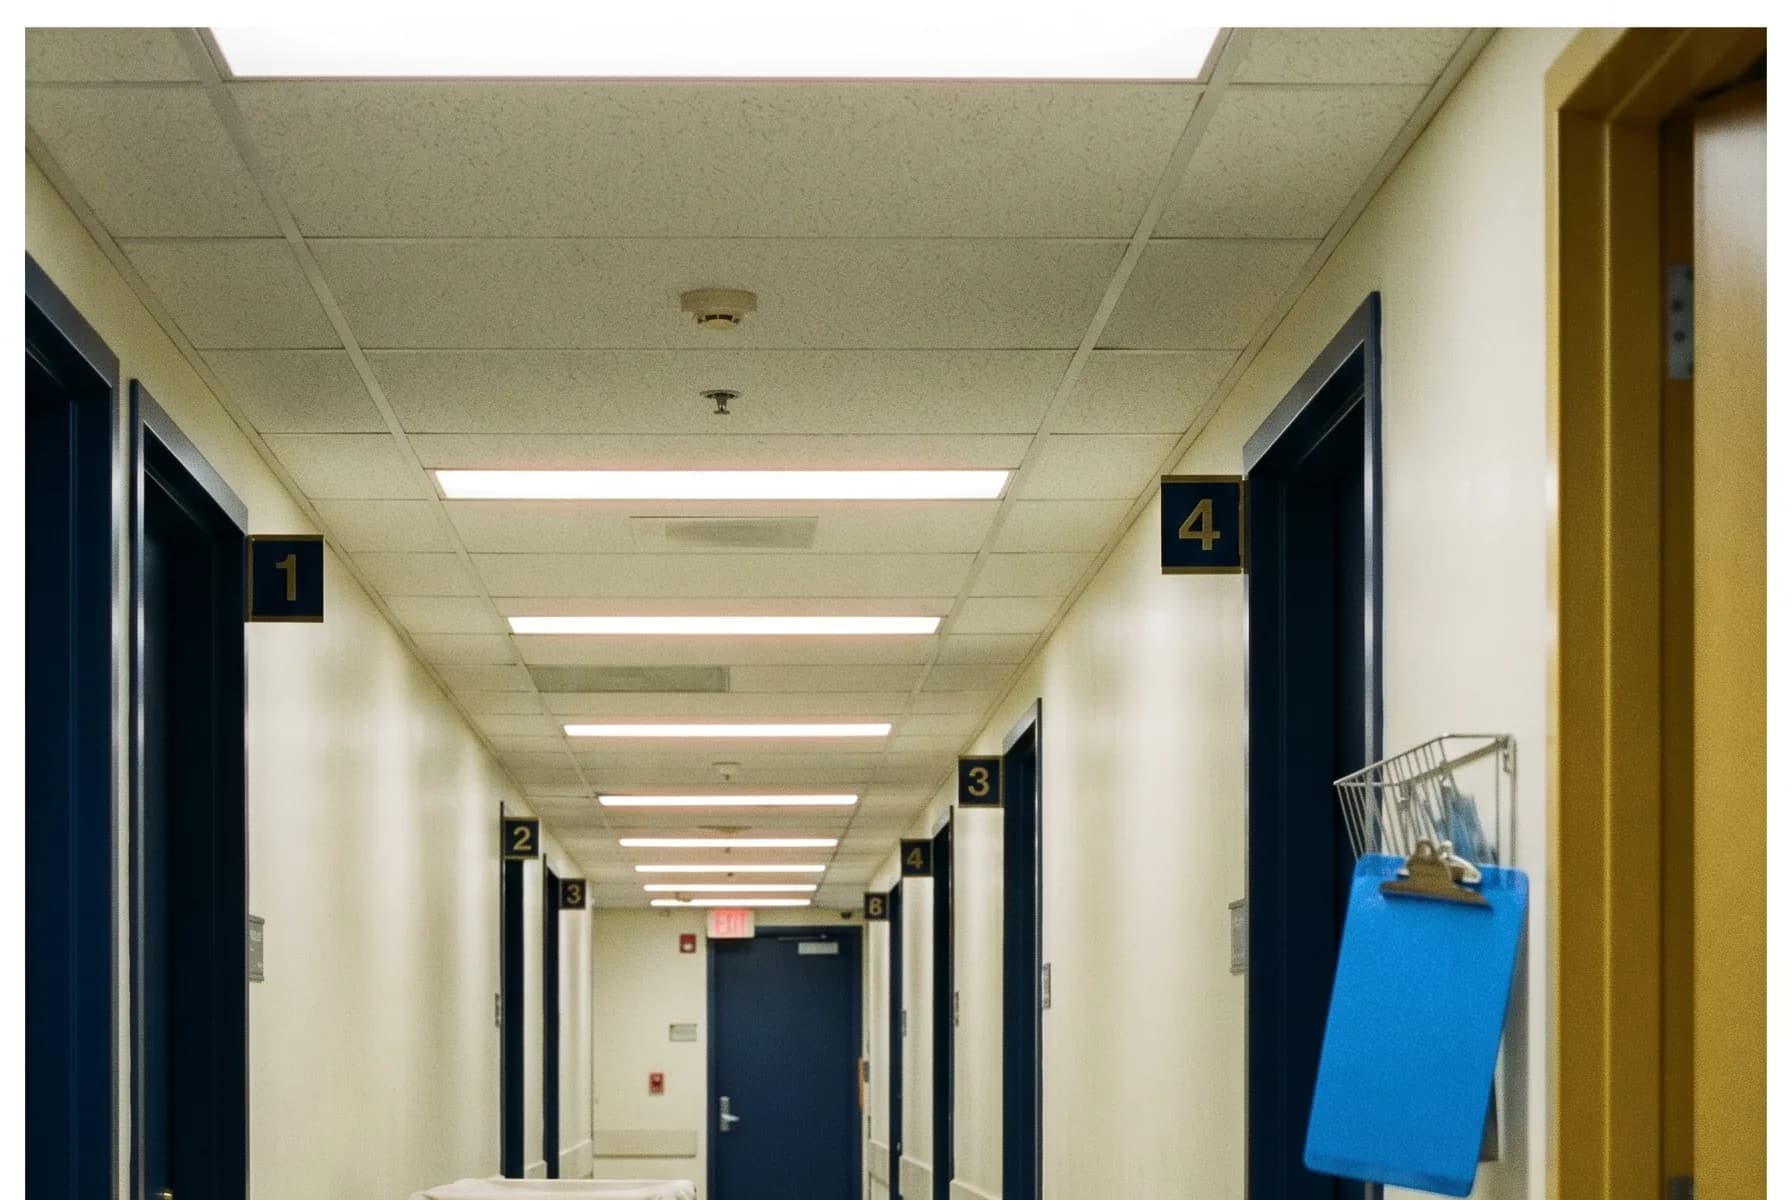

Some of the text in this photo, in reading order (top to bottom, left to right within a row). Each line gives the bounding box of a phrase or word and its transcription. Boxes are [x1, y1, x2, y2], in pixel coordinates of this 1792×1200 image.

[1178, 498, 1221, 551] 4
[275, 553, 297, 602] 1
[967, 766, 990, 798] 3
[512, 826, 532, 851] 2
[906, 847, 924, 870] 4
[566, 884, 581, 904] 3
